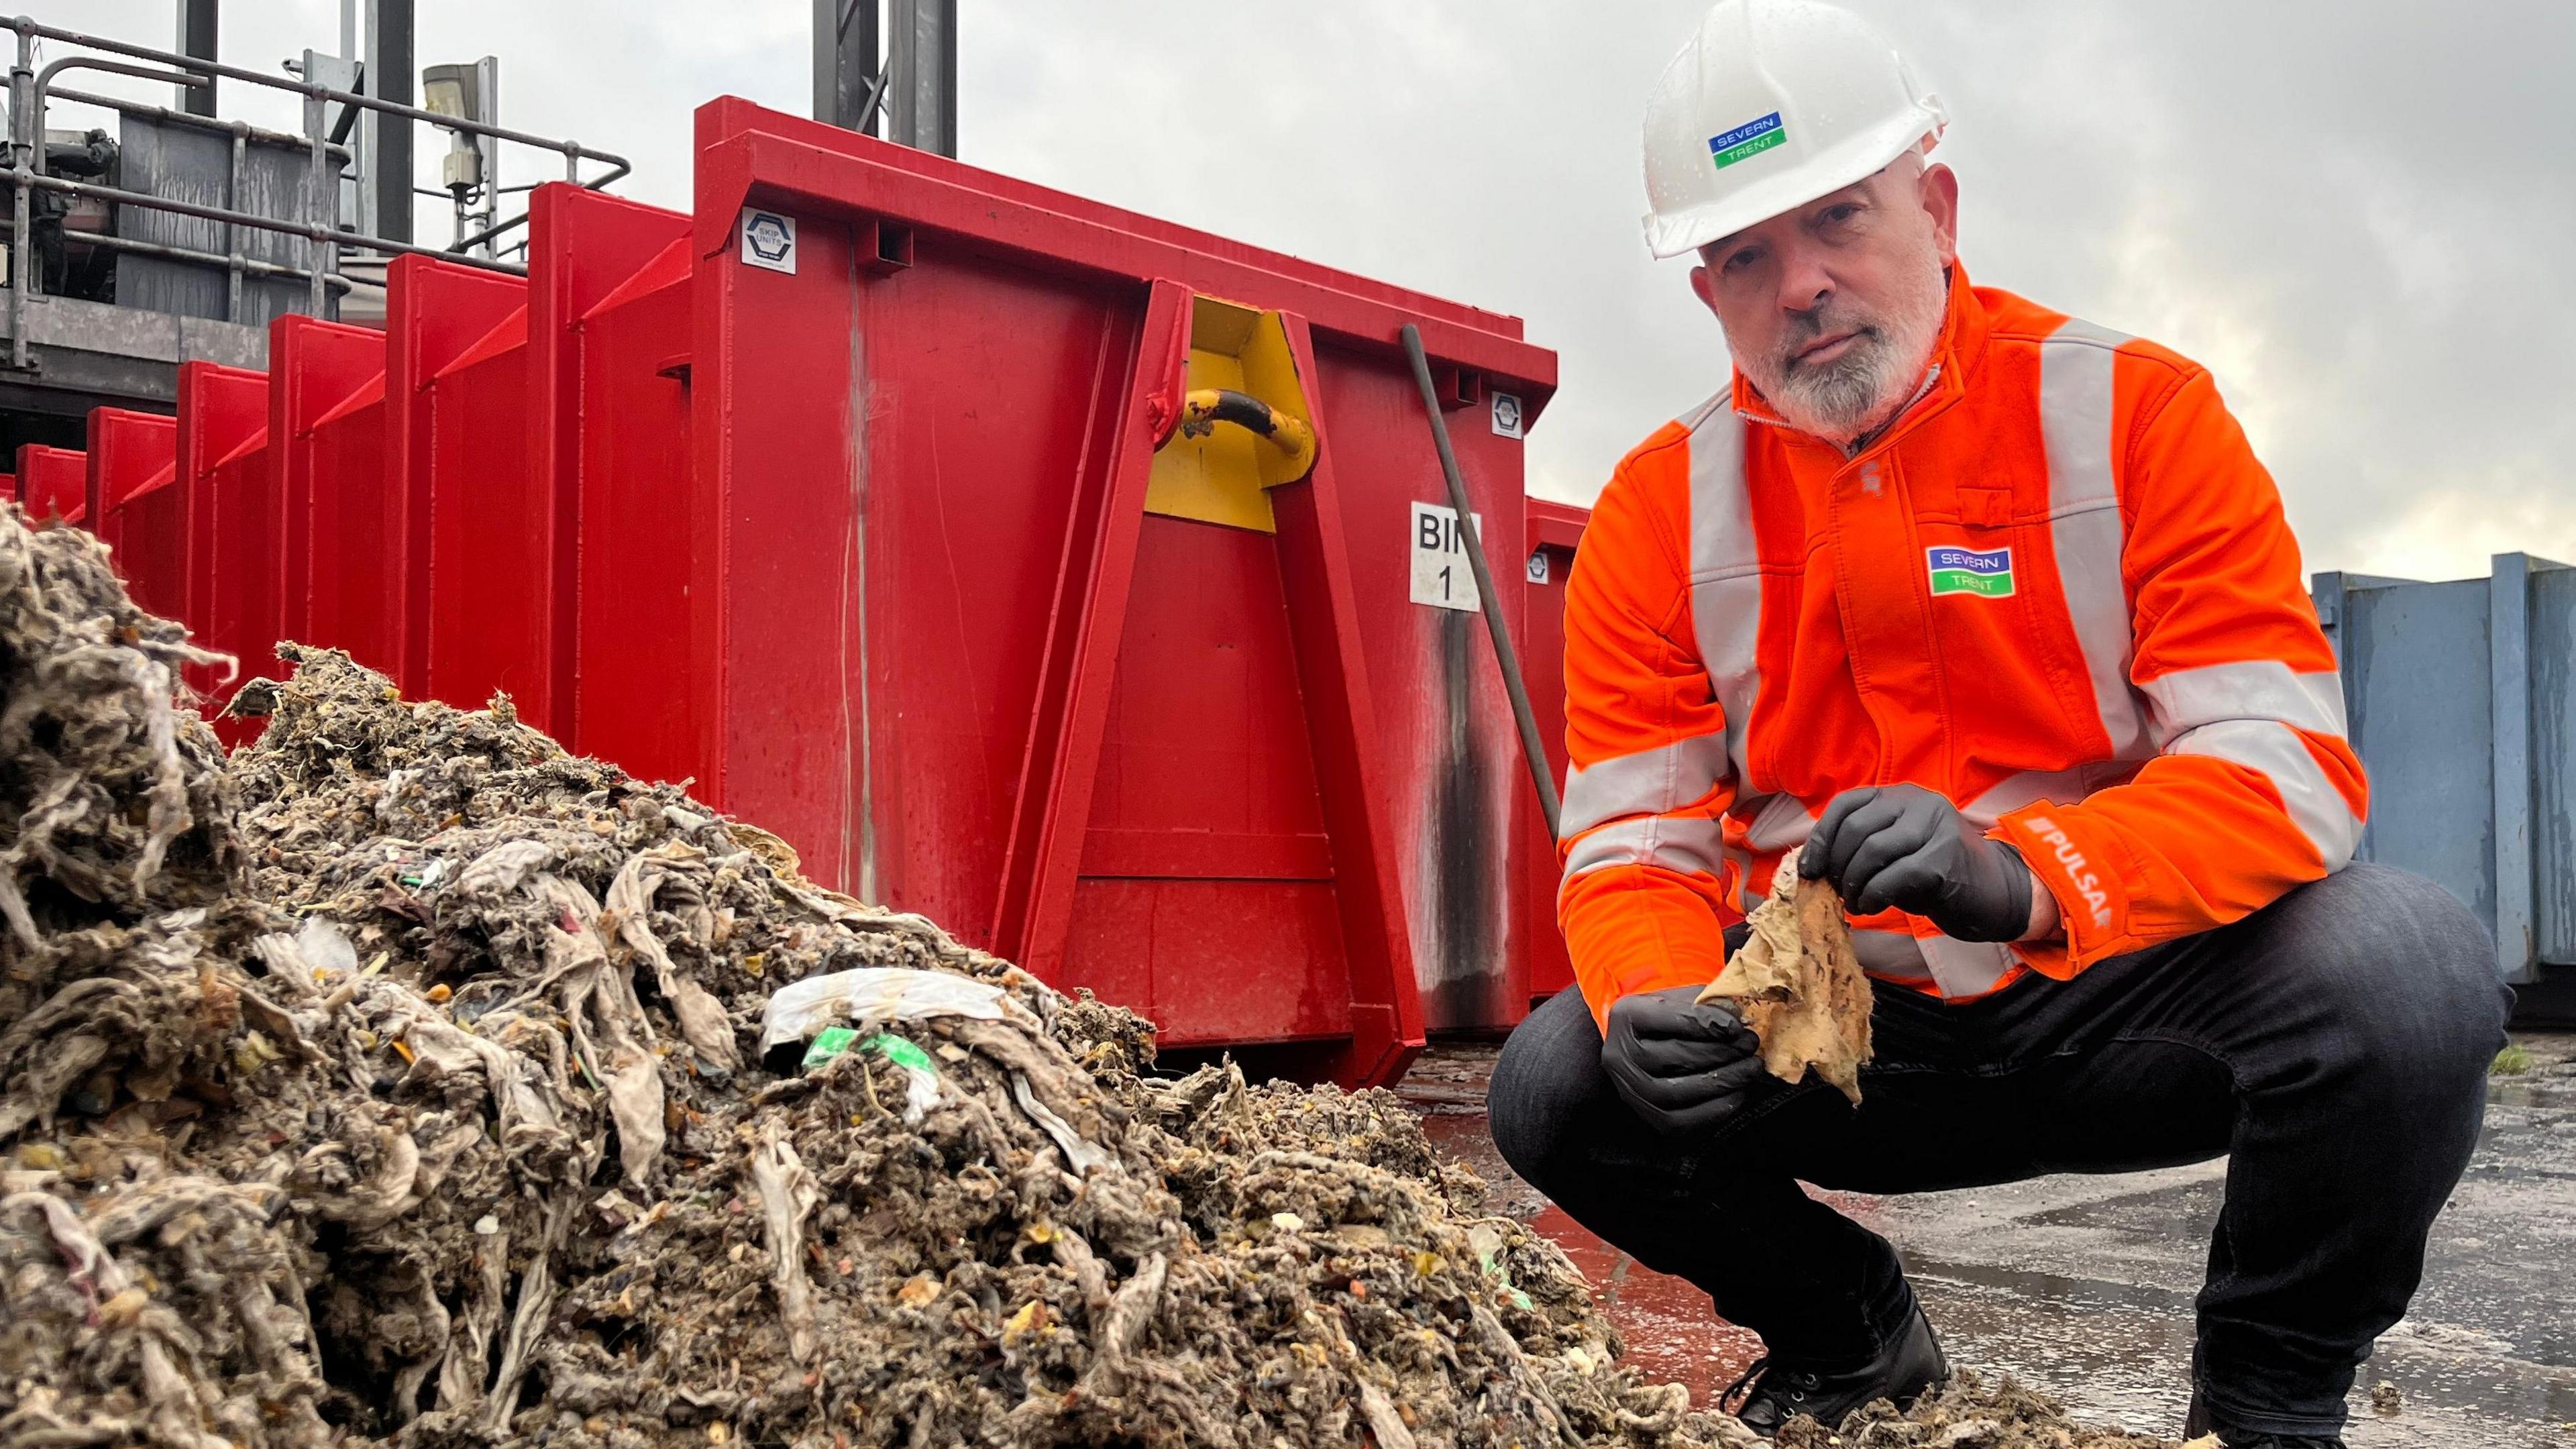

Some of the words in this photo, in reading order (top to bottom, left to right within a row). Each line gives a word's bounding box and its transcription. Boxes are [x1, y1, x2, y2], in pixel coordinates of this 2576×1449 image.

[1717, 118, 1774, 147] SEVERN
[1727, 136, 1772, 160] TRENT
[759, 227, 780, 237] SKIP
[757, 234, 782, 247] UNITS
[1941, 553, 1999, 569] SEVERN
[1439, 566, 1450, 600] 1
[1951, 575, 1993, 590] TRENT
